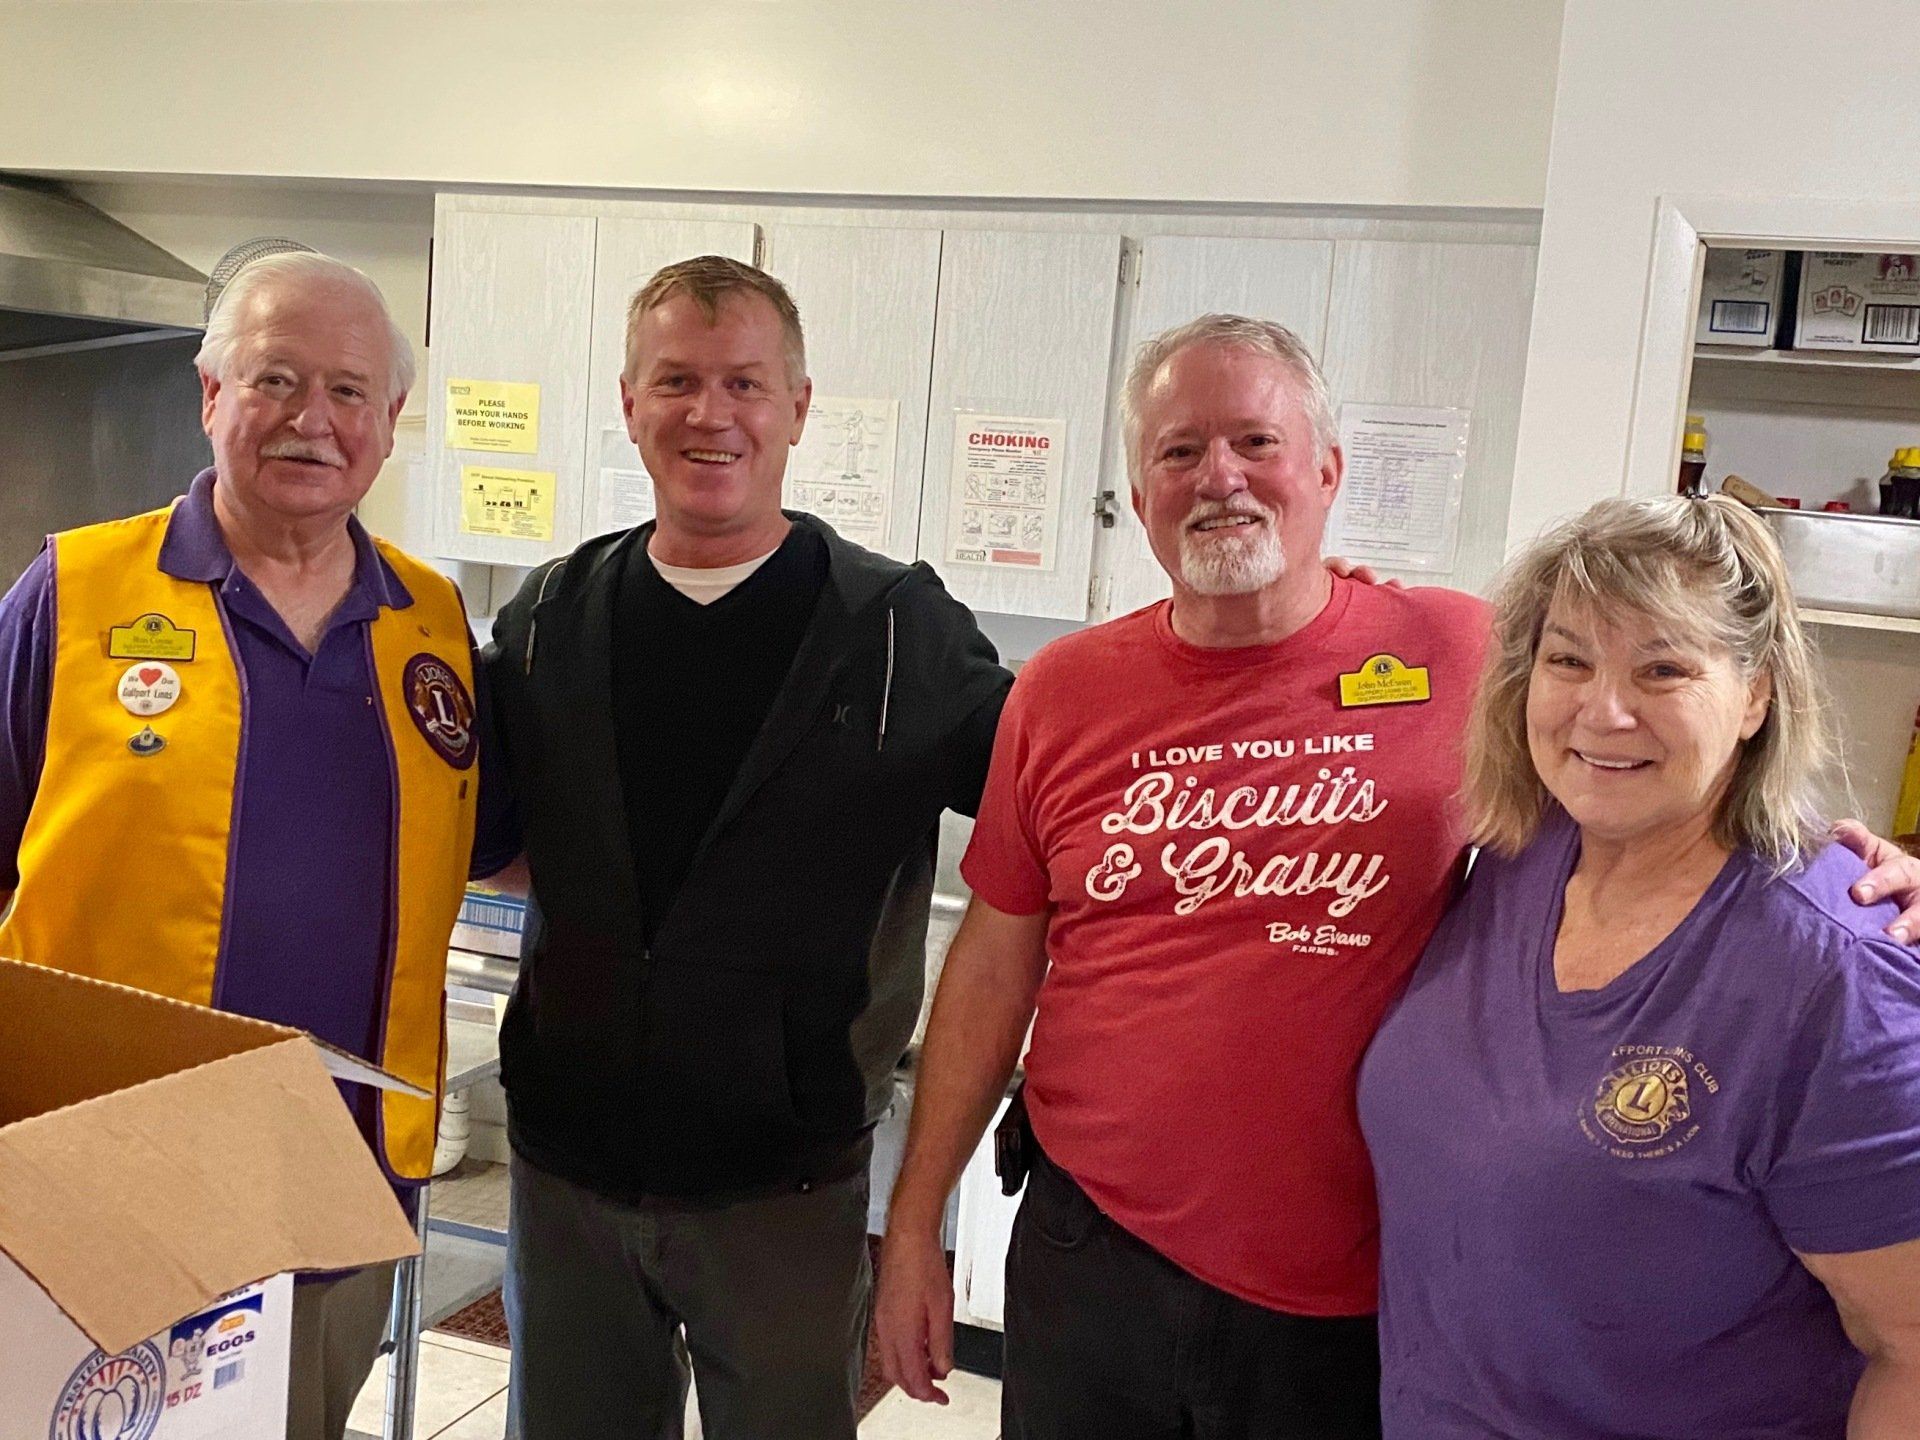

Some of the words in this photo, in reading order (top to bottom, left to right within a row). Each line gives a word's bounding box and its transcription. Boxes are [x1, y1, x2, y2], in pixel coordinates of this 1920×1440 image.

[455, 408, 478, 416] WASH
[479, 410, 501, 418] YOUR
[502, 412, 529, 420] HANDS
[478, 399, 506, 408] PLEASE
[457, 419, 487, 428] BEFORE
[488, 421, 526, 430] WORKING
[968, 432, 1050, 449] CHOKING
[1132, 751, 1140, 769] I
[1149, 744, 1223, 768] LOVE
[1231, 739, 1295, 760] YOU
[1304, 733, 1375, 755] LIKE
[1100, 766, 1389, 836] Biscuits
[1085, 842, 1142, 902] &
[1160, 836, 1390, 918] Gravy
[1265, 921, 1312, 943] Bob
[1313, 924, 1372, 947] Evans
[1291, 944, 1336, 956] FARMS
[1629, 1061, 1682, 1082] LIONS
[1693, 1062, 1720, 1095] CLUB
[206, 1330, 256, 1358] EGGS
[165, 1390, 181, 1410] 15
[183, 1381, 204, 1404] DZ
